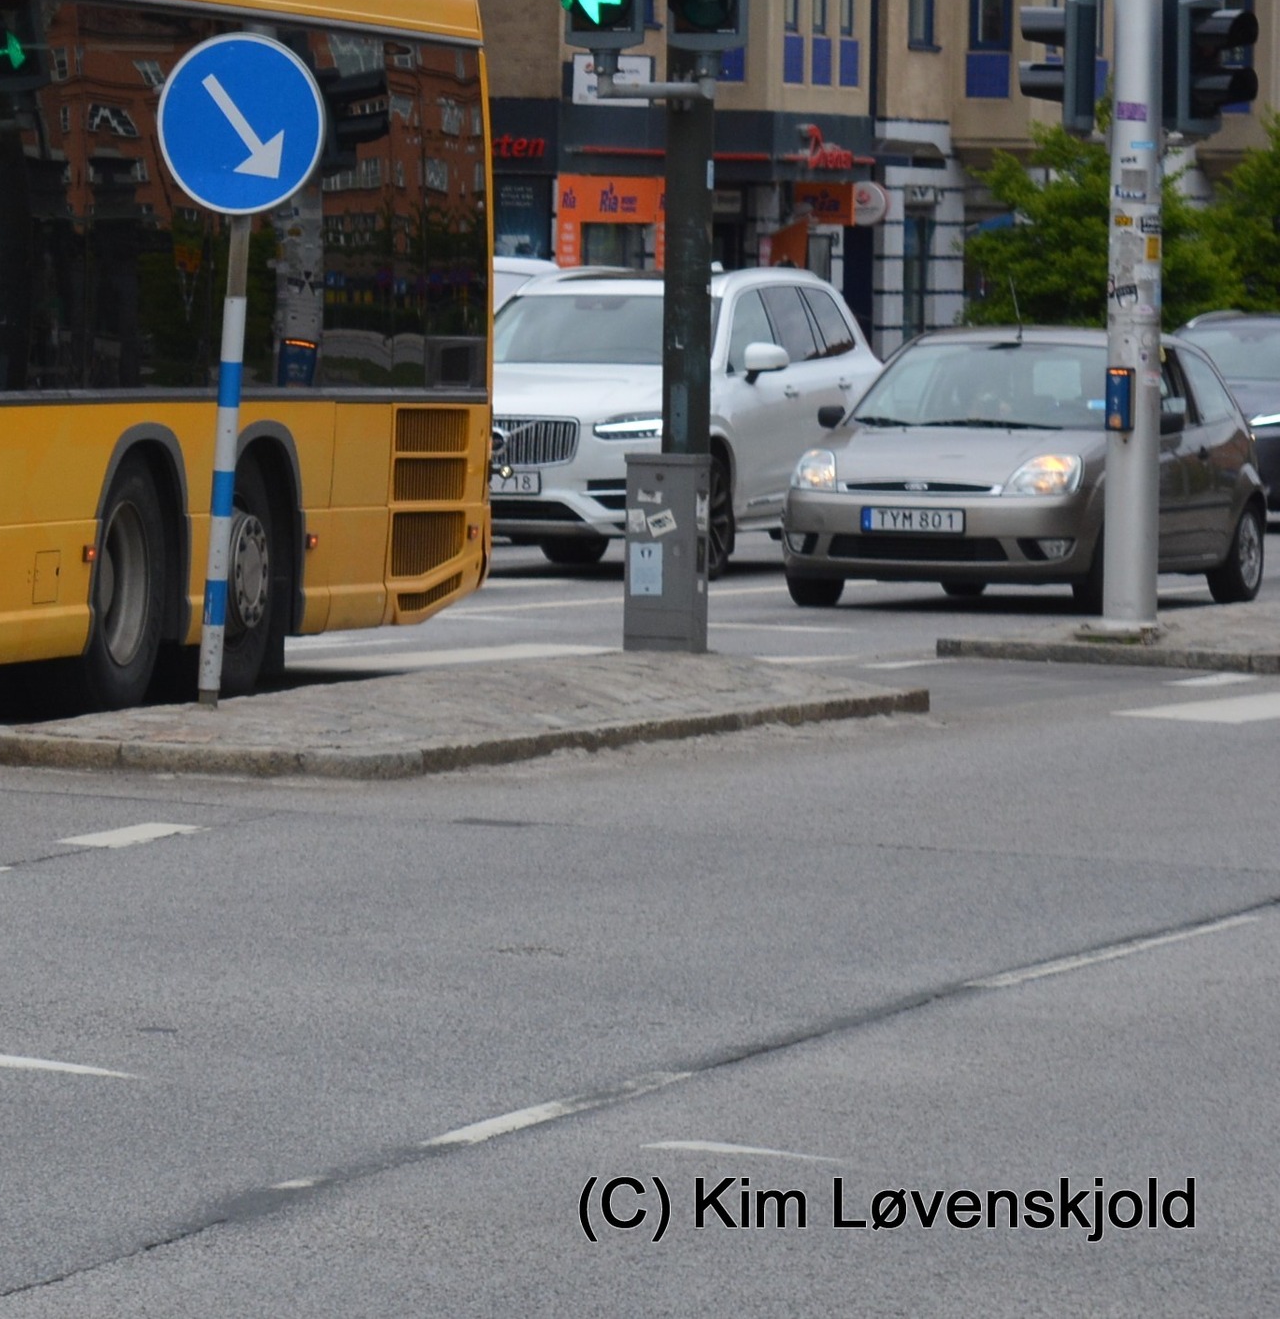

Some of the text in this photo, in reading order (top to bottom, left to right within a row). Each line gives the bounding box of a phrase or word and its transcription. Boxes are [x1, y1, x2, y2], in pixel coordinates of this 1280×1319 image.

[600, 182, 619, 213] Ria
[878, 509, 954, 531] TYM 801
